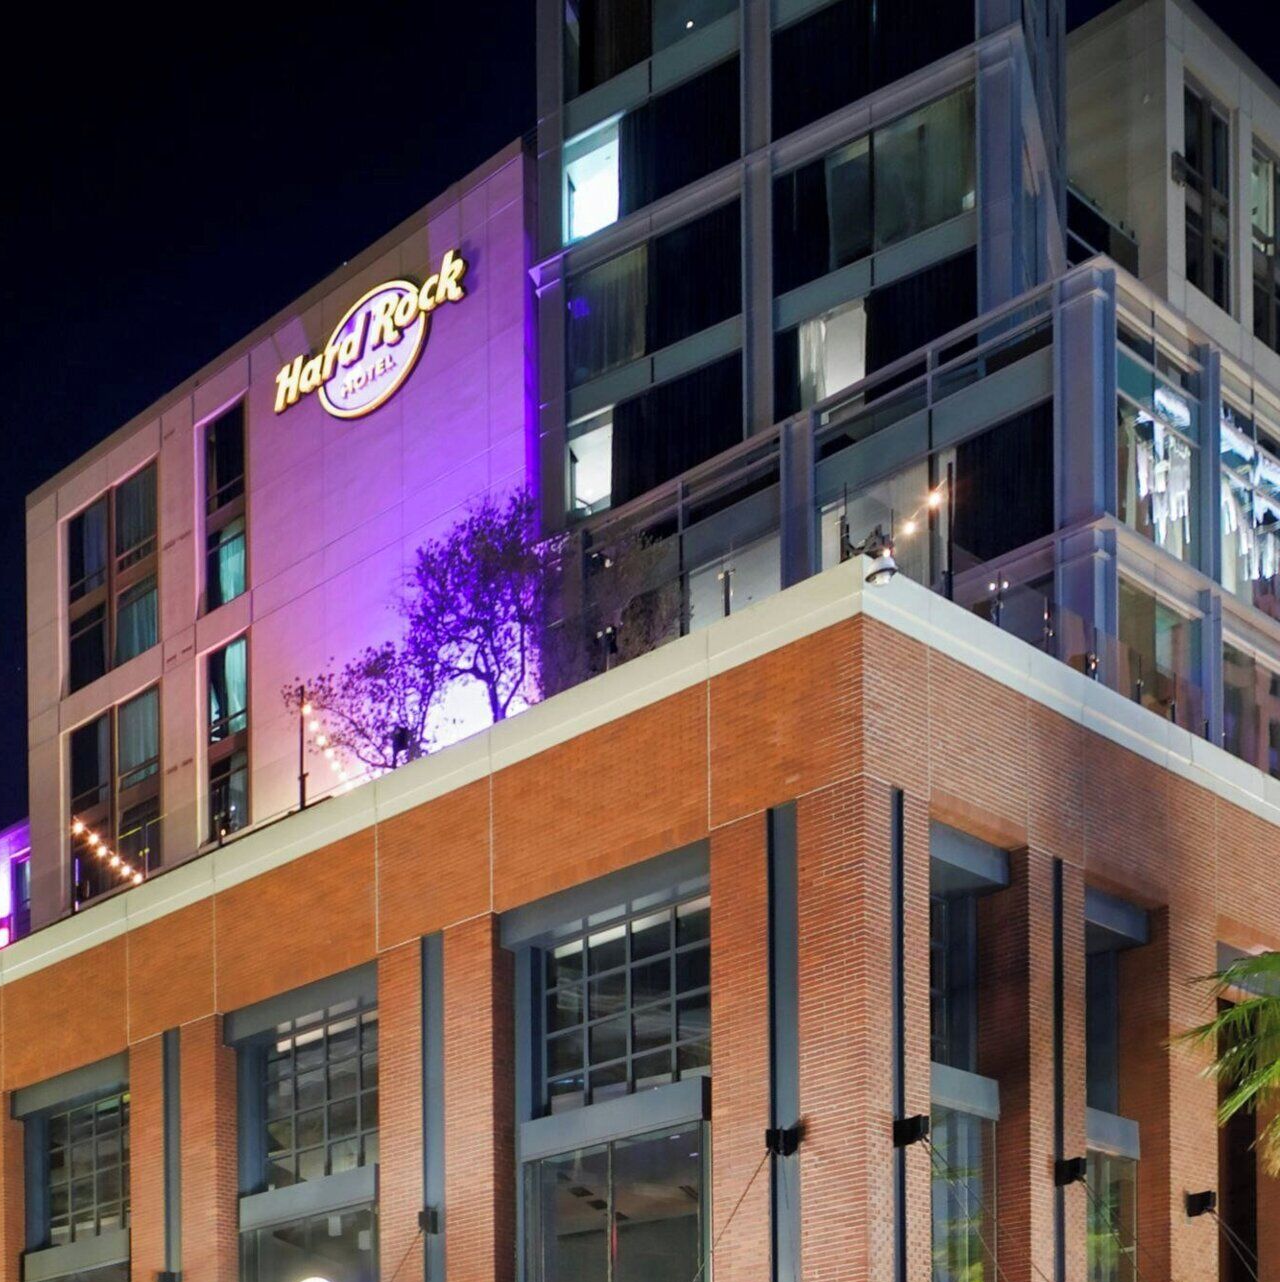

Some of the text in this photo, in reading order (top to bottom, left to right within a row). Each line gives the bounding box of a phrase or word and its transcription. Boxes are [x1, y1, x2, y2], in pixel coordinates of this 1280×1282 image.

[274, 249, 467, 414] Hard Rock
[340, 355, 396, 398] HOTEL
